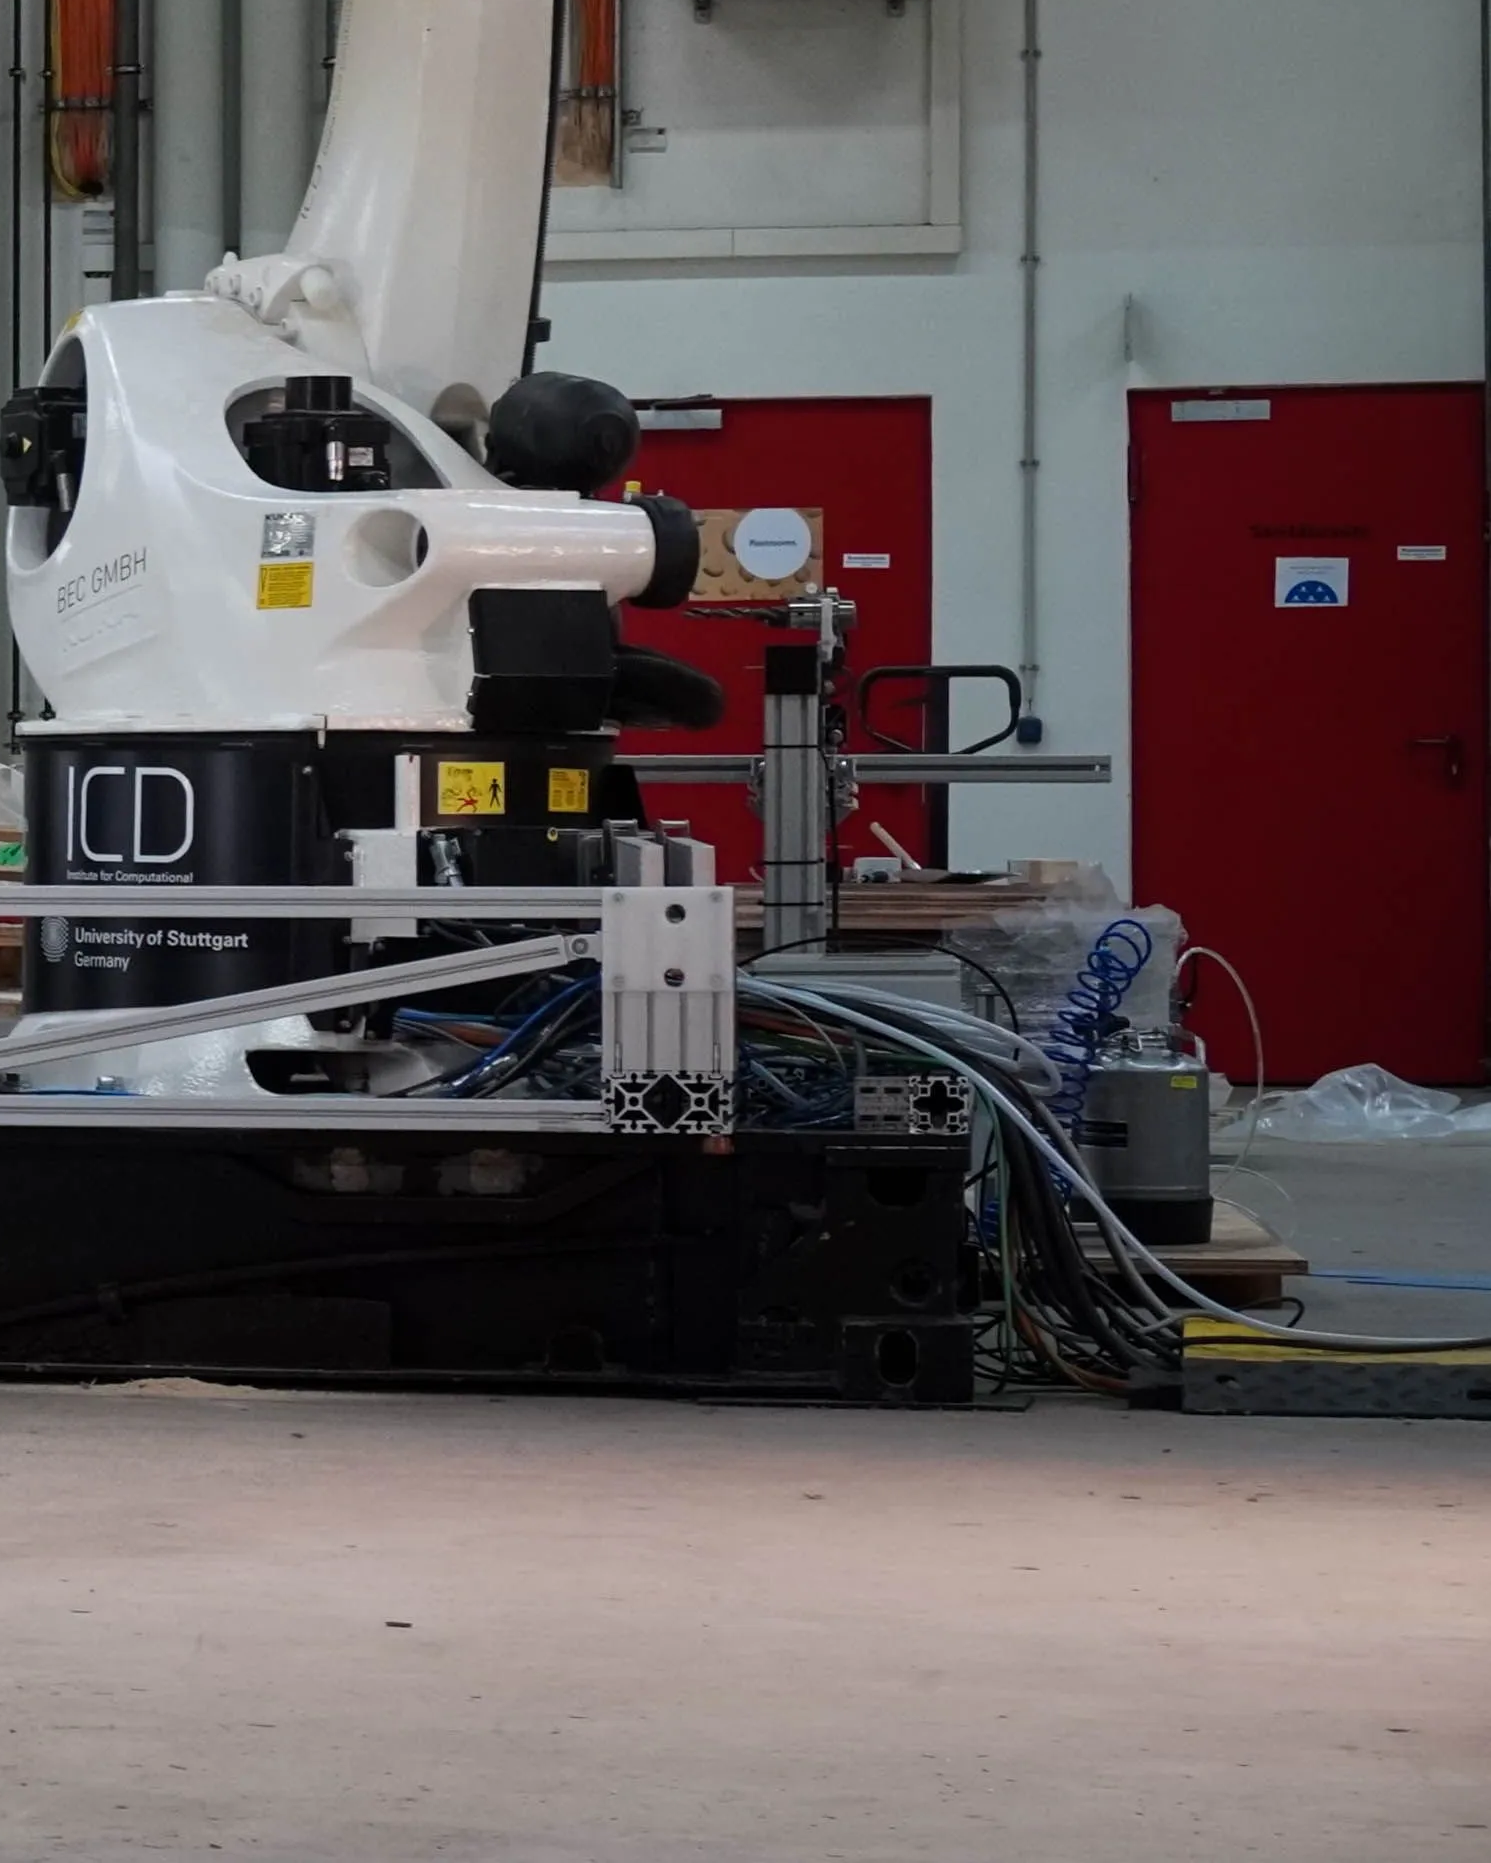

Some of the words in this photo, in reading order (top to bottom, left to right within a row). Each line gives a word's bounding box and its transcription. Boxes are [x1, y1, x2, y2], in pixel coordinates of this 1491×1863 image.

[56, 575, 87, 615] BEC
[91, 547, 148, 595] GMBH
[67, 765, 195, 863] ICD
[99, 869, 114, 881] for
[115, 870, 194, 884] Computational
[74, 927, 143, 949] University
[146, 930, 164, 946] of
[166, 930, 249, 951] Stuttgart
[74, 951, 131, 972] Germany
